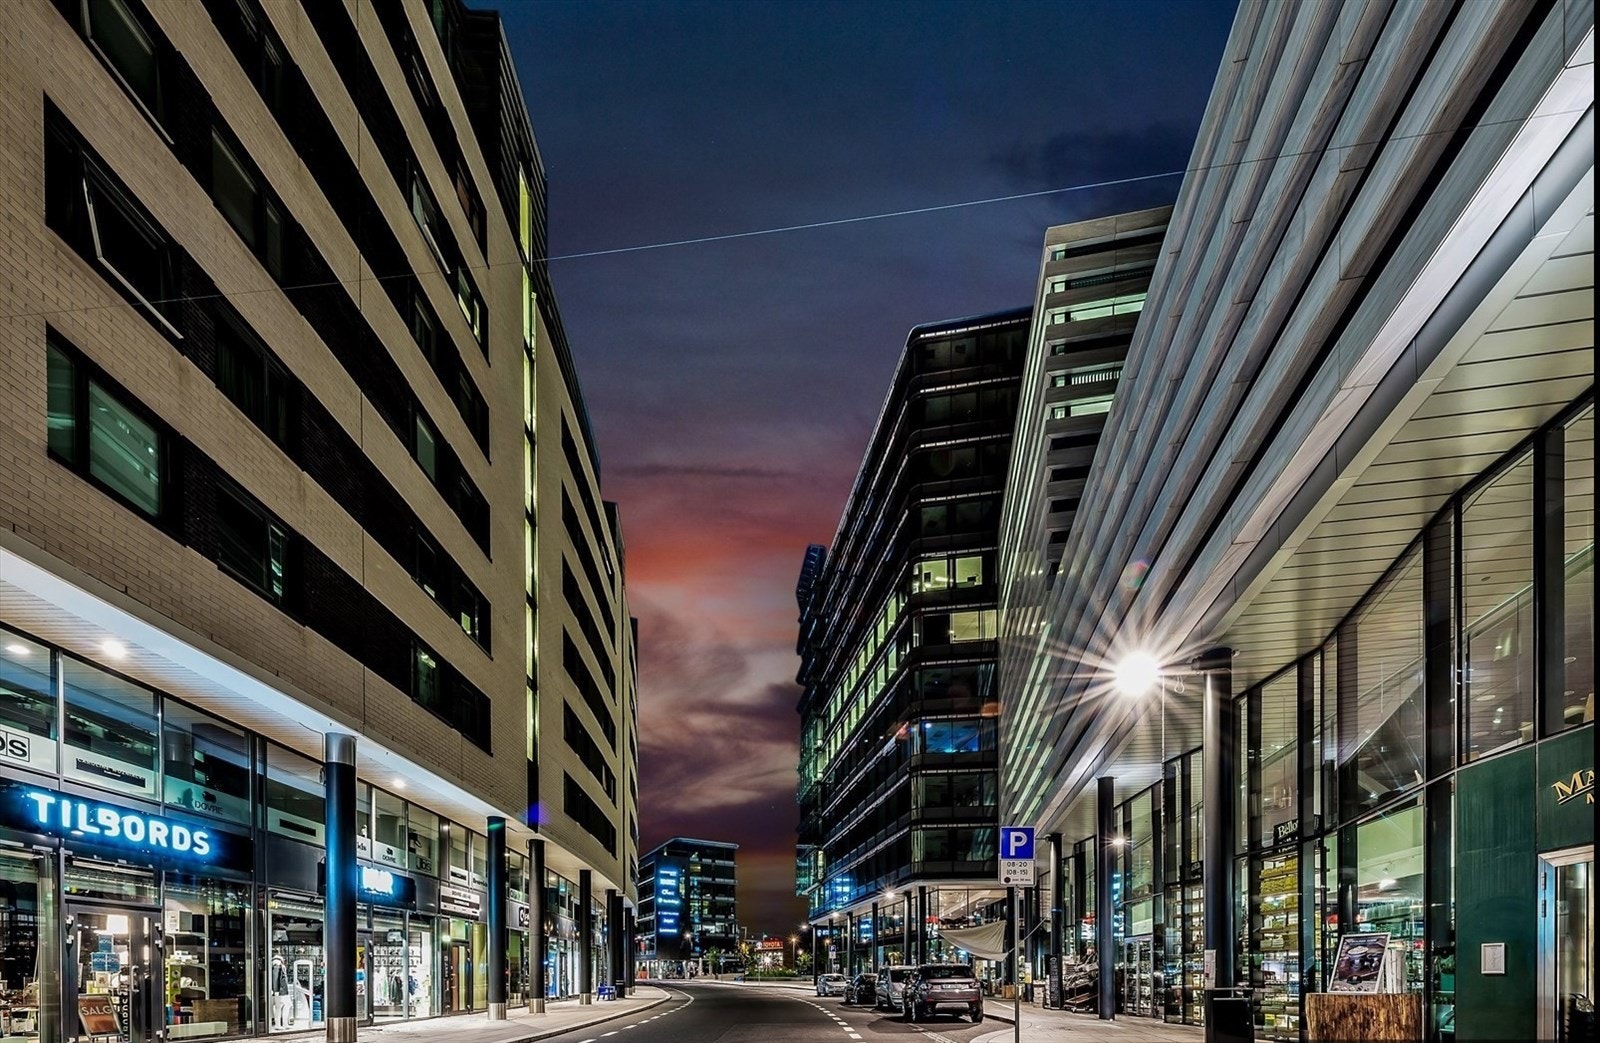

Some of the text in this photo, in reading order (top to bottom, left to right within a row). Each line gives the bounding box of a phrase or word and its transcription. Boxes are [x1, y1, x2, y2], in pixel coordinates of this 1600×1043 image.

[194, 800, 224, 816] DOVRE
[30, 792, 211, 856] TILBORDS
[1010, 831, 1028, 856] P
[81, 1005, 113, 1016] SALG
